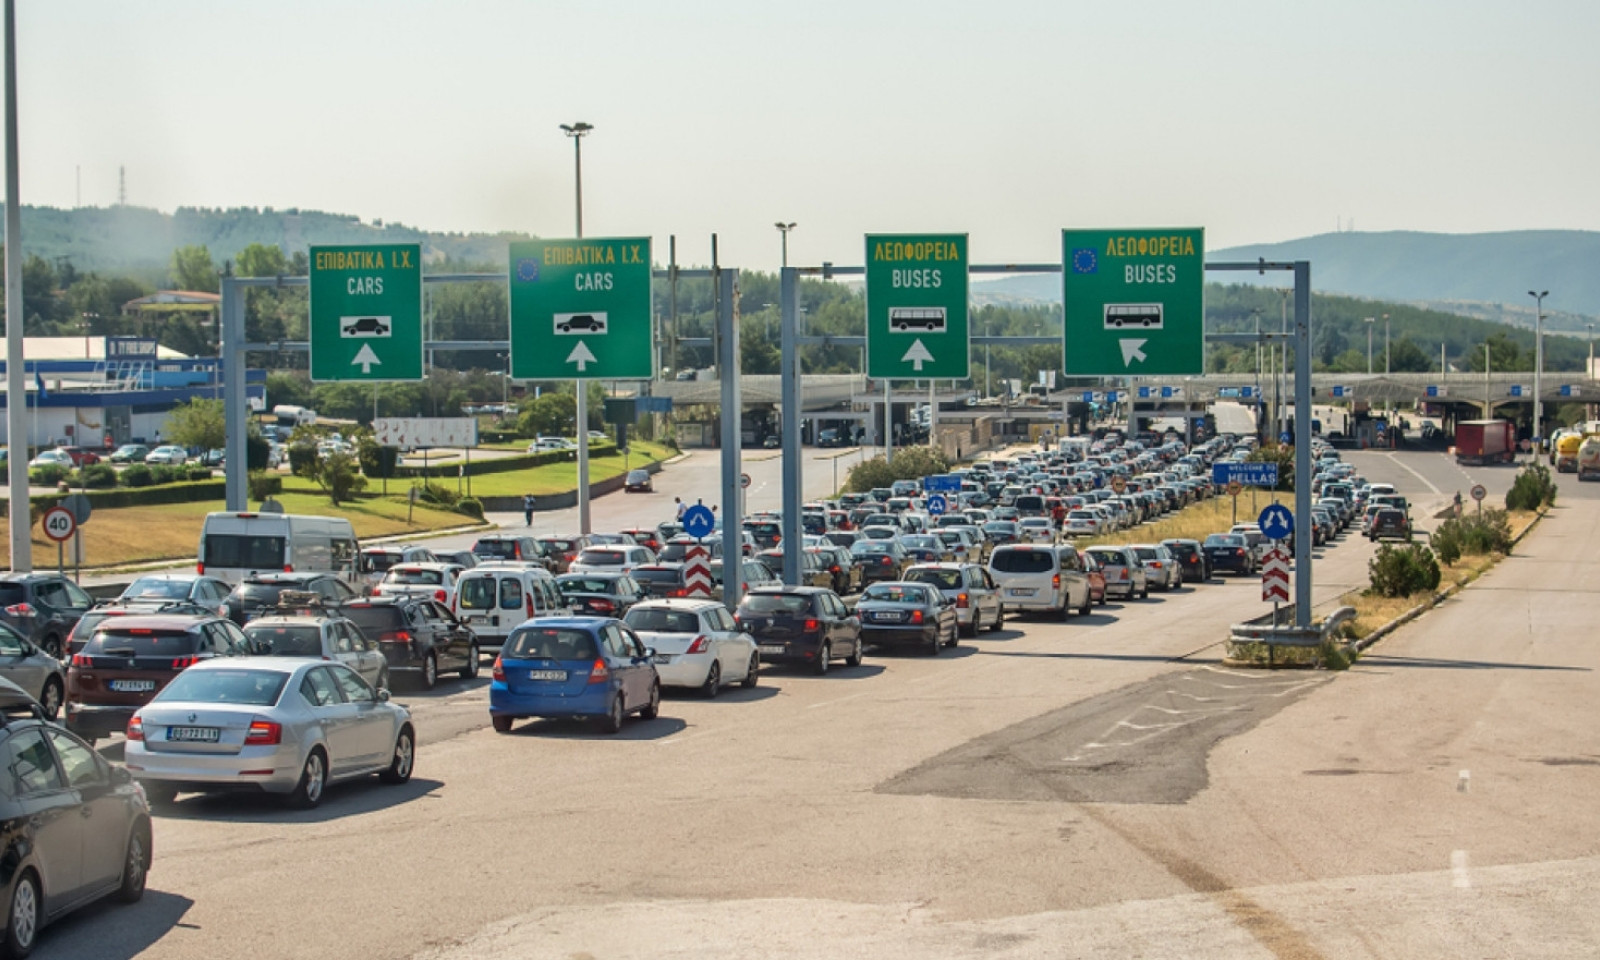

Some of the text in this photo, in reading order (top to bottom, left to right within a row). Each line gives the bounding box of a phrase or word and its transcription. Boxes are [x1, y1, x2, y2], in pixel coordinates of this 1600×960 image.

[574, 271, 614, 291] CARS
[891, 268, 942, 288] BUSES
[1124, 264, 1176, 283] BUSES
[347, 276, 384, 295] CARS
[1227, 472, 1276, 484] HELLAS
[49, 516, 68, 531] 40
